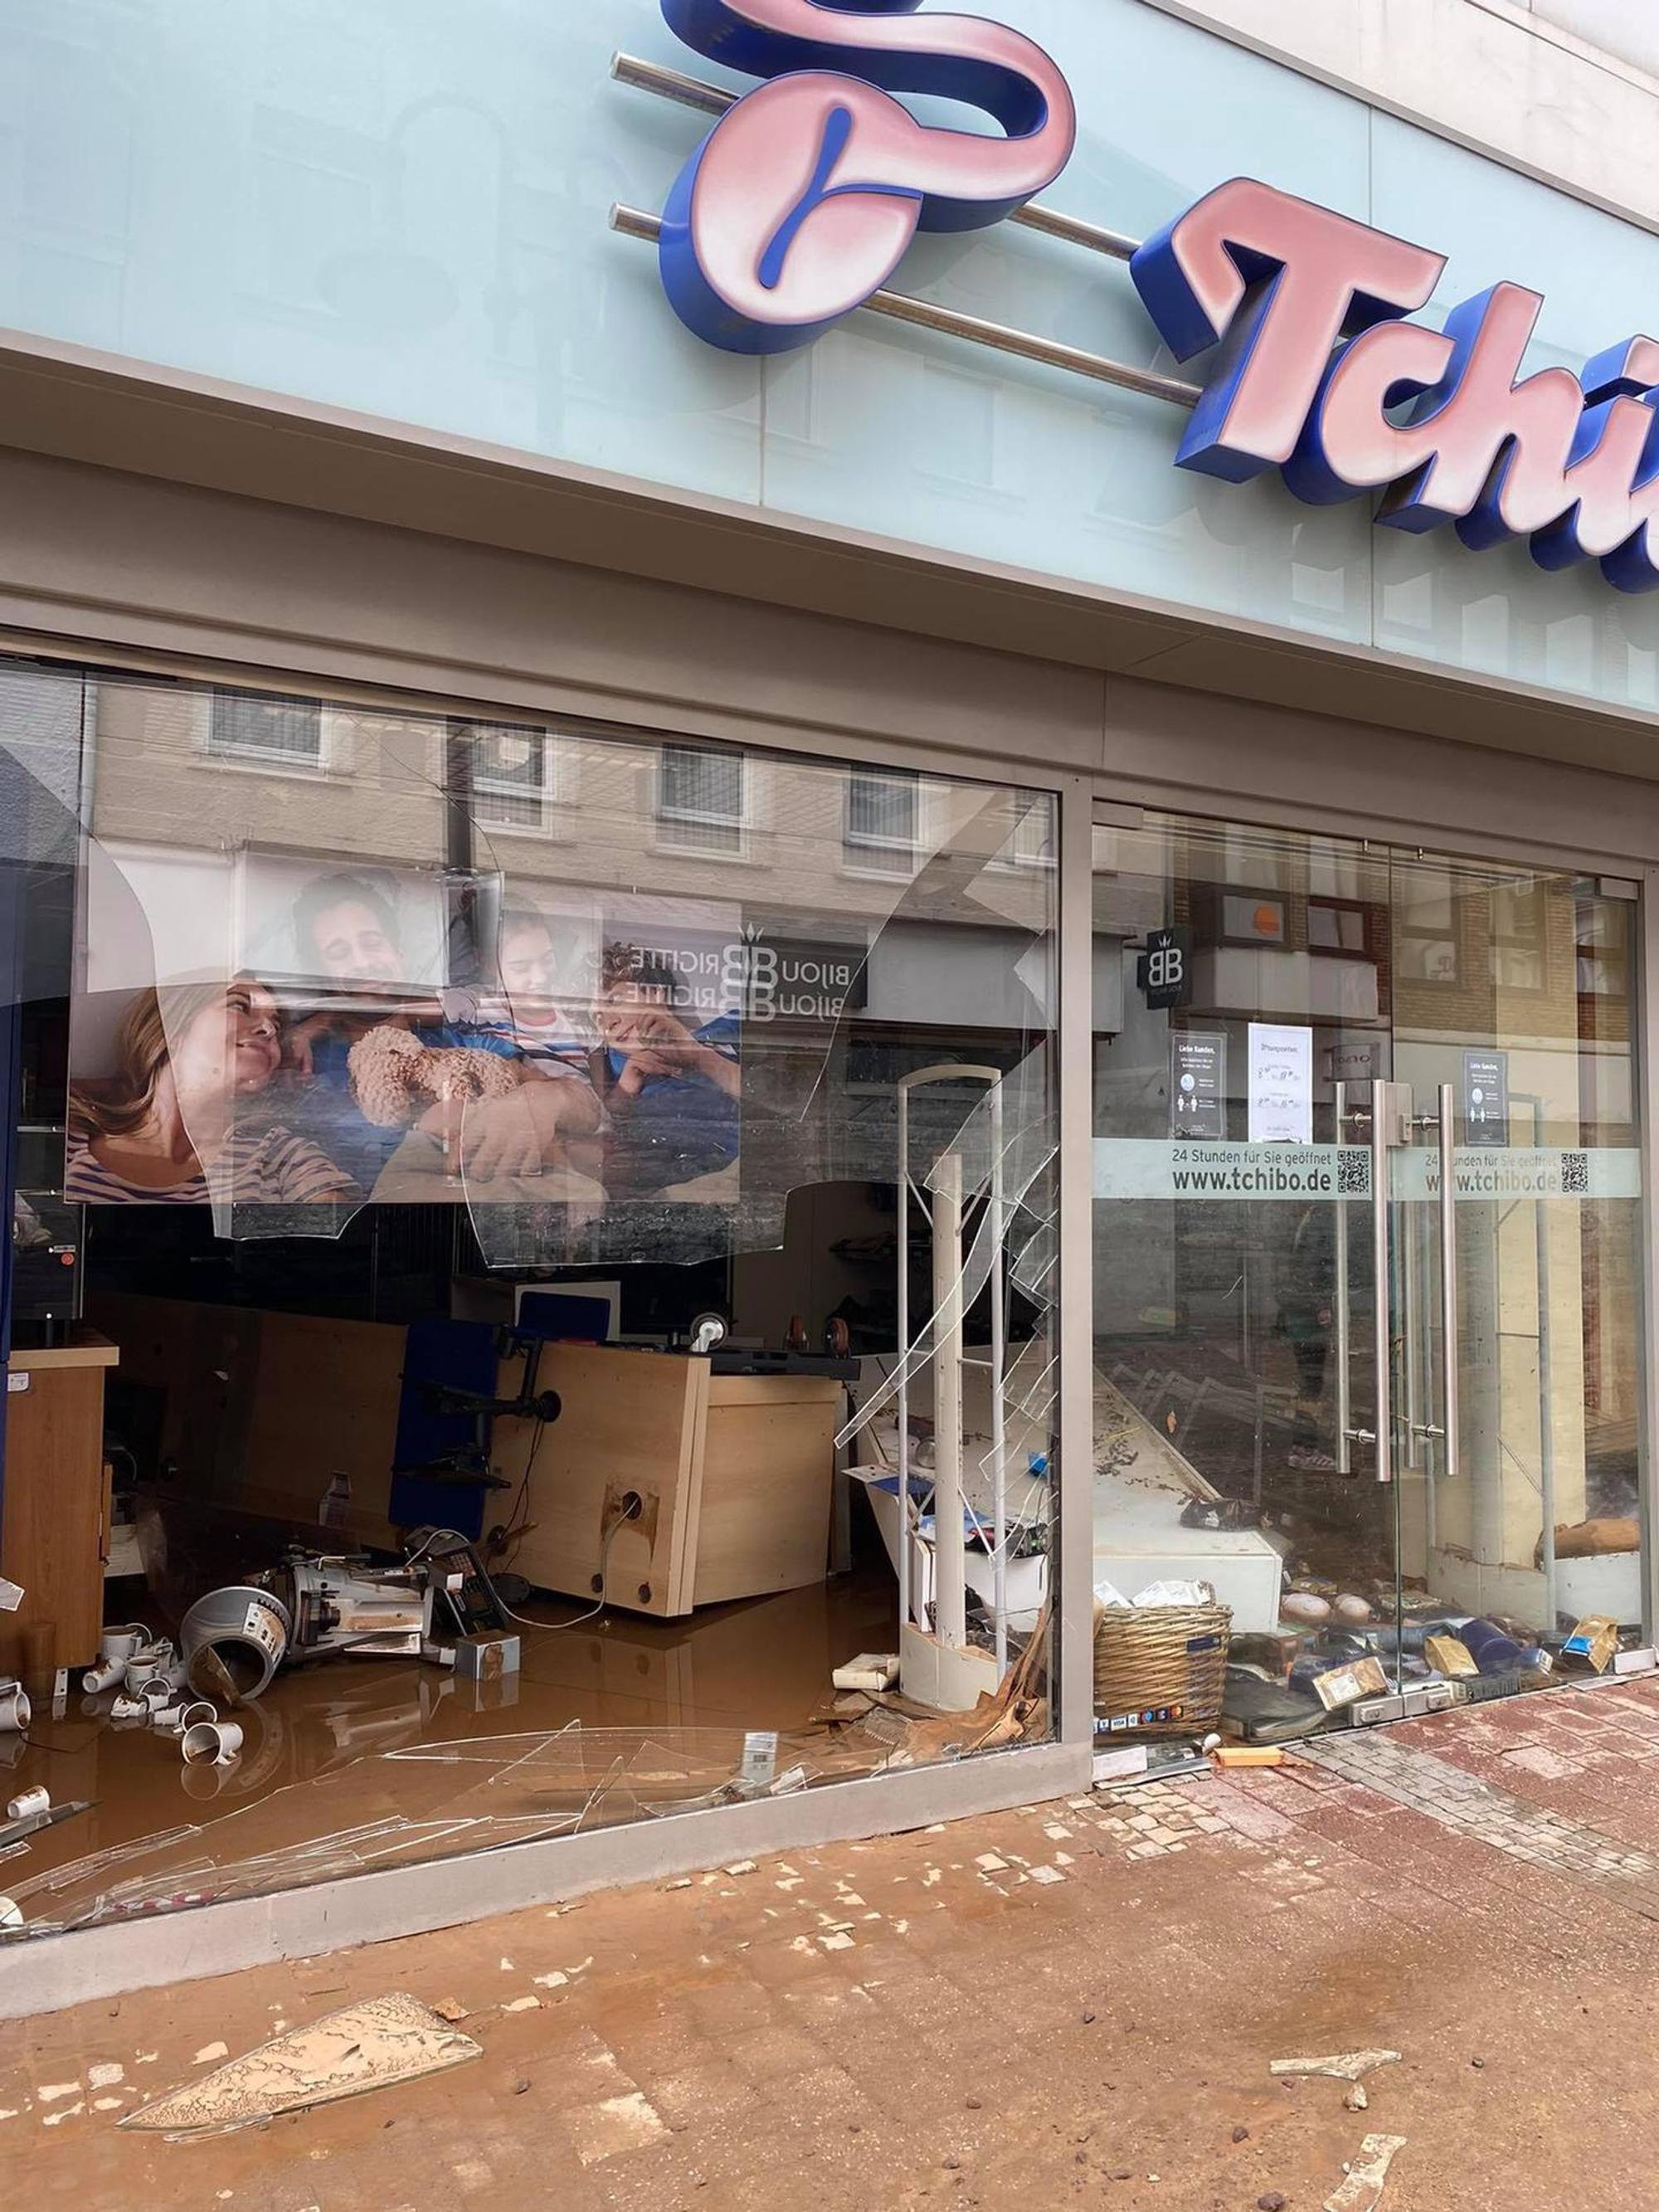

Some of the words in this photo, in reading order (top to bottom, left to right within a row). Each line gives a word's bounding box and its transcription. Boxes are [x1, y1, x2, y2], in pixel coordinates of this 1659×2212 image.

[1168, 177, 1659, 574] Tchi
[1172, 1149, 1188, 1162] 24
[1192, 1150, 1240, 1163] Stunden
[1244, 1151, 1259, 1164] für
[1264, 1151, 1282, 1164] Sie
[1286, 1152, 1331, 1167] geöffnet
[1425, 1154, 1438, 1167] 24
[1450, 1155, 1482, 1167] unden
[1485, 1154, 1497, 1167] für
[1501, 1154, 1516, 1167] Sie
[1173, 1167, 1331, 1191] www.tchibo.de
[1426, 1171, 1557, 1191] ww.tchibo.de
